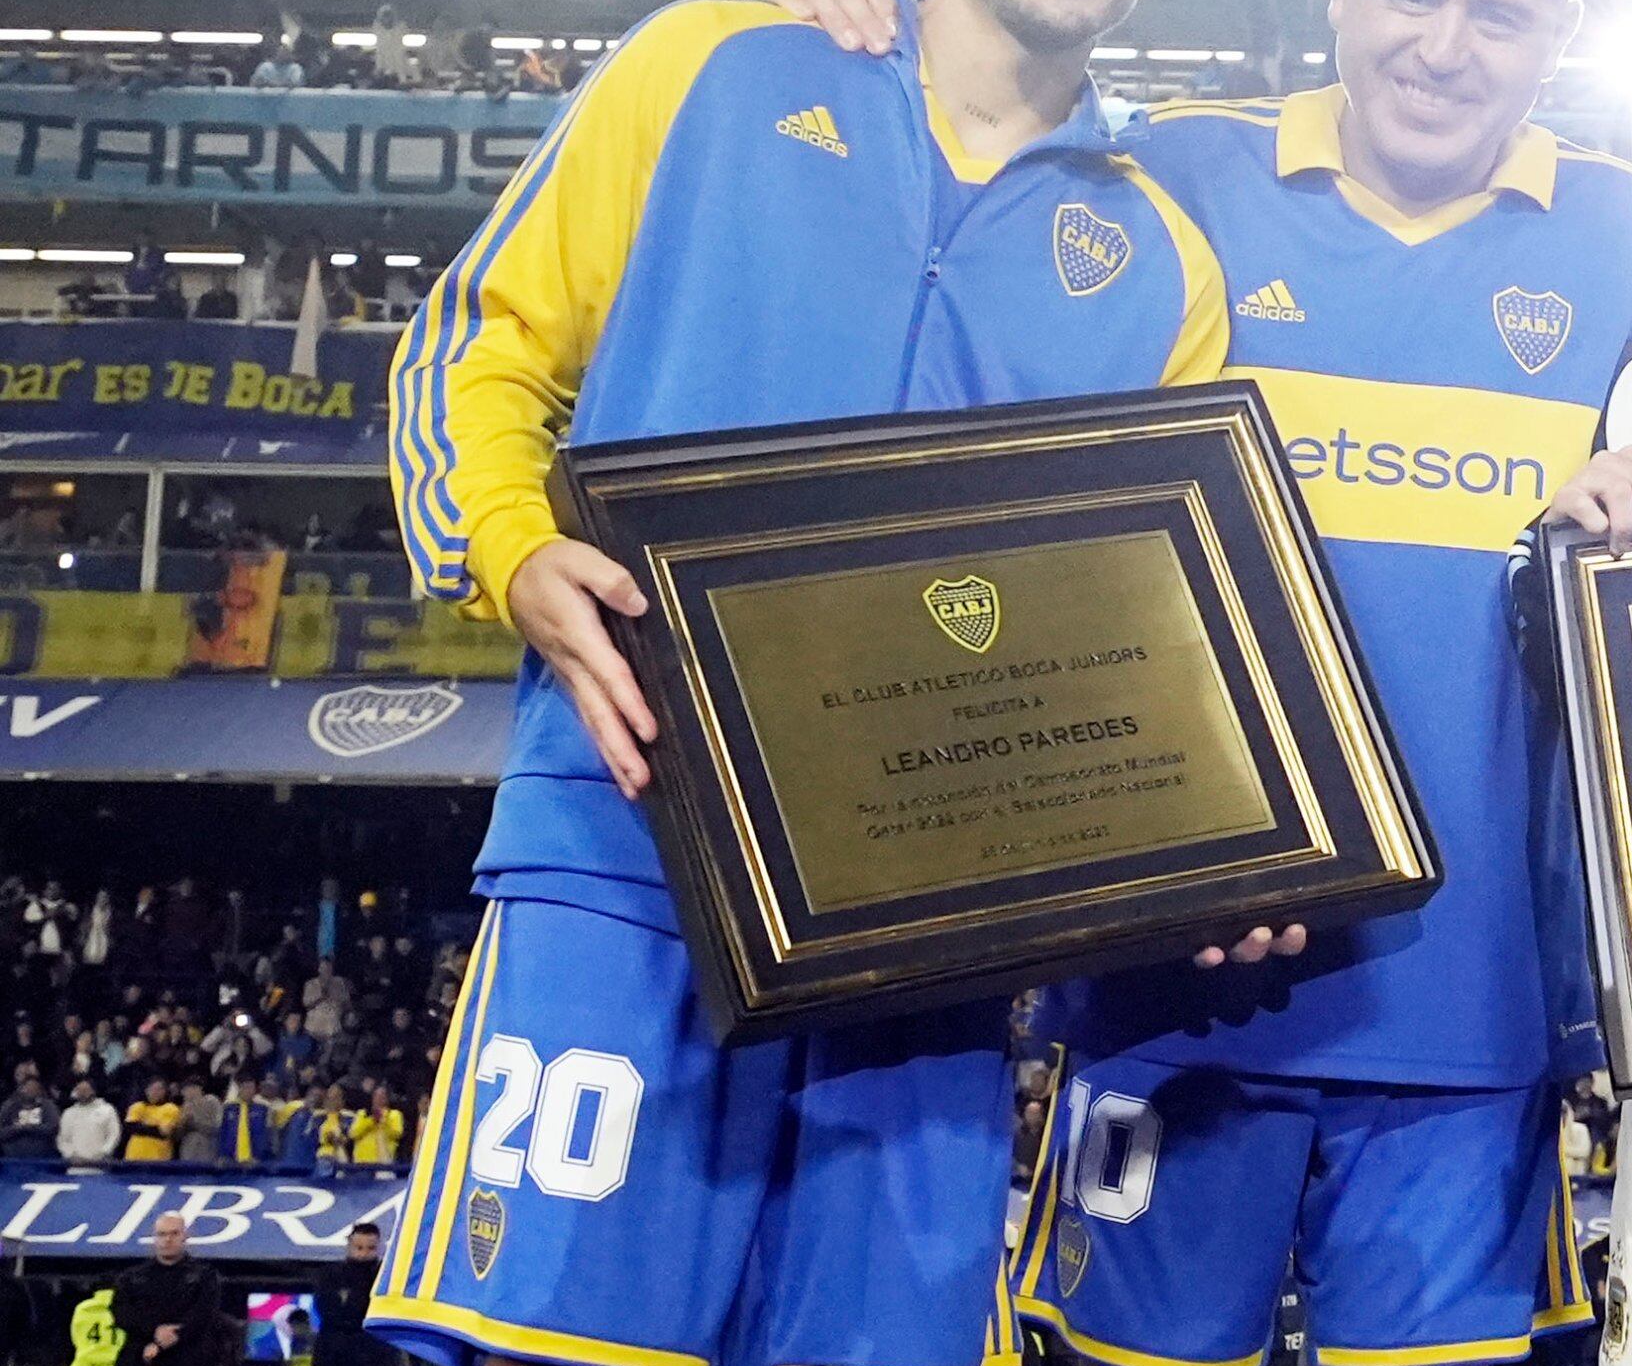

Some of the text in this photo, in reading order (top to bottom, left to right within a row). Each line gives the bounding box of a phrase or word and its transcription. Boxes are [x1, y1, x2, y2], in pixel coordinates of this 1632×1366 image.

[775, 119, 849, 158] adidas
[1062, 224, 1118, 270] CABJ
[1236, 302, 1306, 323] adidas
[1503, 312, 1561, 336] CABJ
[93, 363, 151, 405] ES
[223, 360, 356, 419] BOCA
[936, 596, 994, 620] CABJ
[1067, 644, 1149, 673] JUNIORS
[880, 714, 1140, 777] LEANDRO PAREDES
[469, 1031, 646, 1203] 20
[1060, 1075, 1164, 1225] 10
